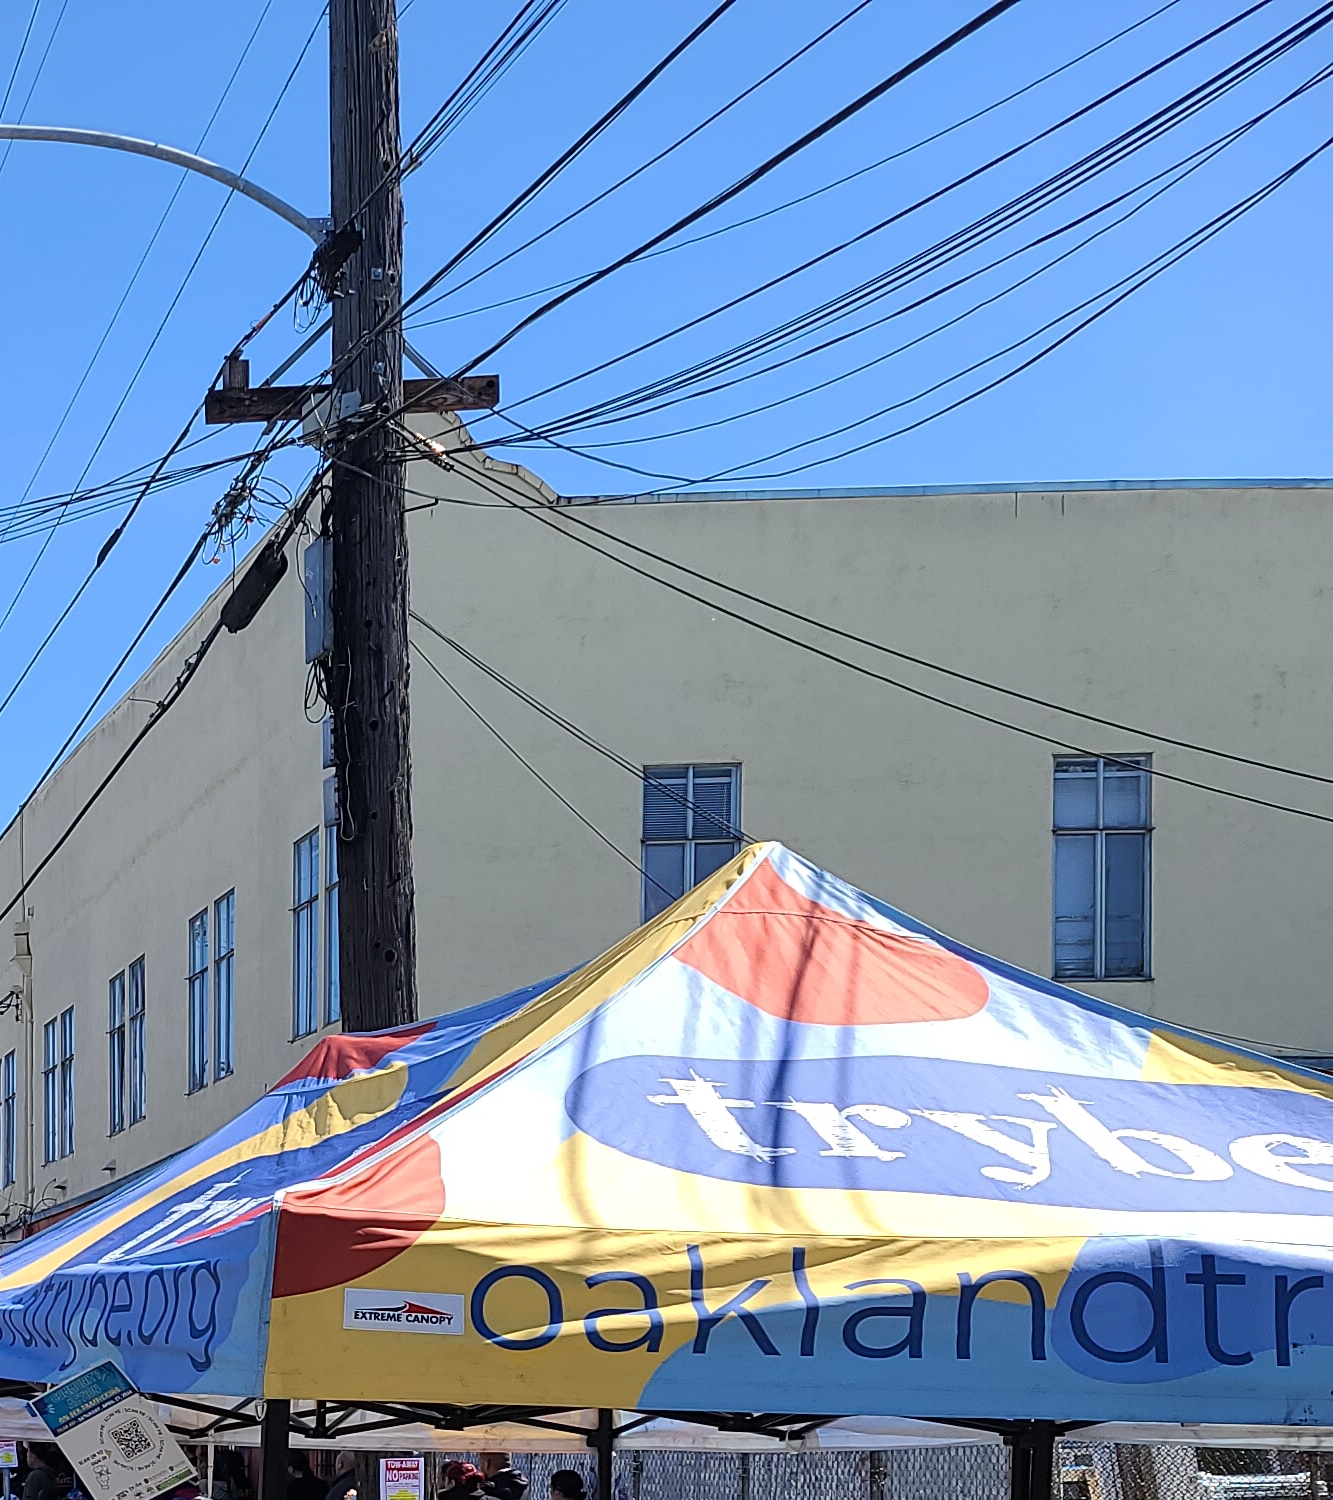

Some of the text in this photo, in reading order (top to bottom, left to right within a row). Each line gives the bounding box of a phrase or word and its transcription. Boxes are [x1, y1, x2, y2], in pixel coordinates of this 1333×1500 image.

[646, 1068, 1332, 1190] trybe
[353, 1310, 454, 1326] EXTREME CANOPY
[386, 1461, 419, 1469] TOW-AWAY
[386, 1470, 419, 1481] NO PARKING
